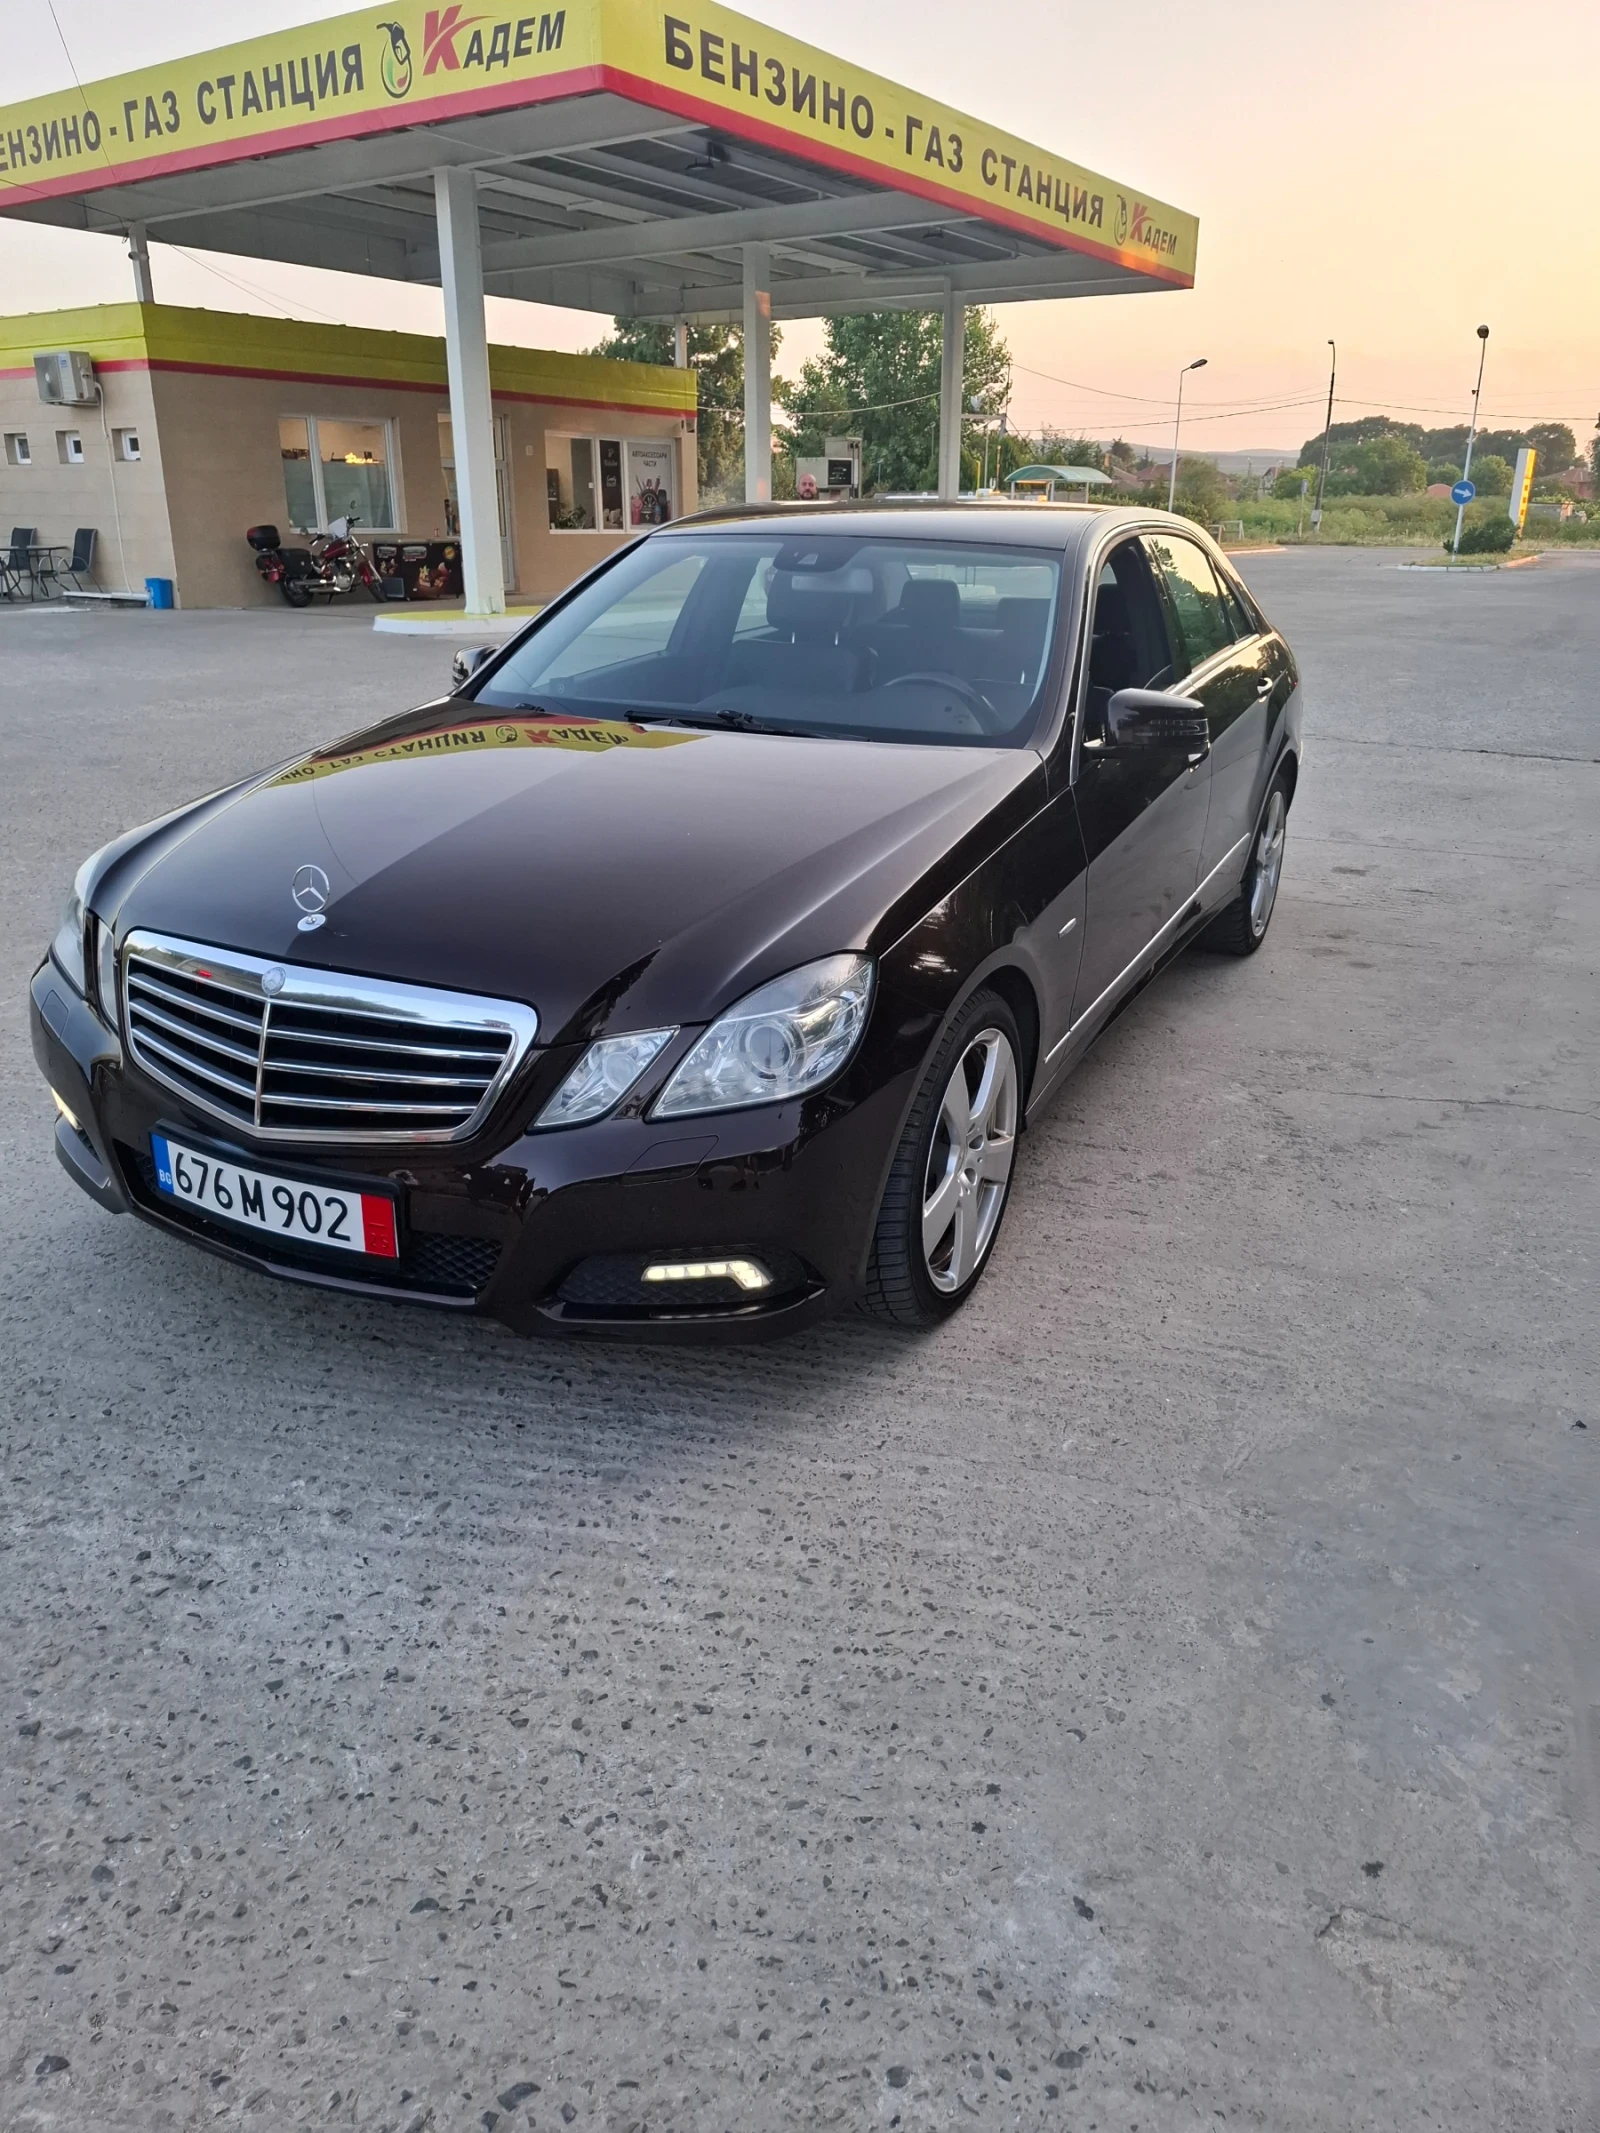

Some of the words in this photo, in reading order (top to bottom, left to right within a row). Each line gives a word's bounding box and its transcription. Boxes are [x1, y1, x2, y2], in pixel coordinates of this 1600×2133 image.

[0, 110, 101, 172] ЕНЗИНО
[123, 90, 180, 143] ГАЗ
[197, 43, 364, 125] СТАНЦИЯ
[664, 14, 874, 139] БЕНЗИНО
[905, 114, 963, 173] ГАЗ
[981, 148, 1104, 229] СТАНЦИЯ
[158, 1169, 172, 1185] BG
